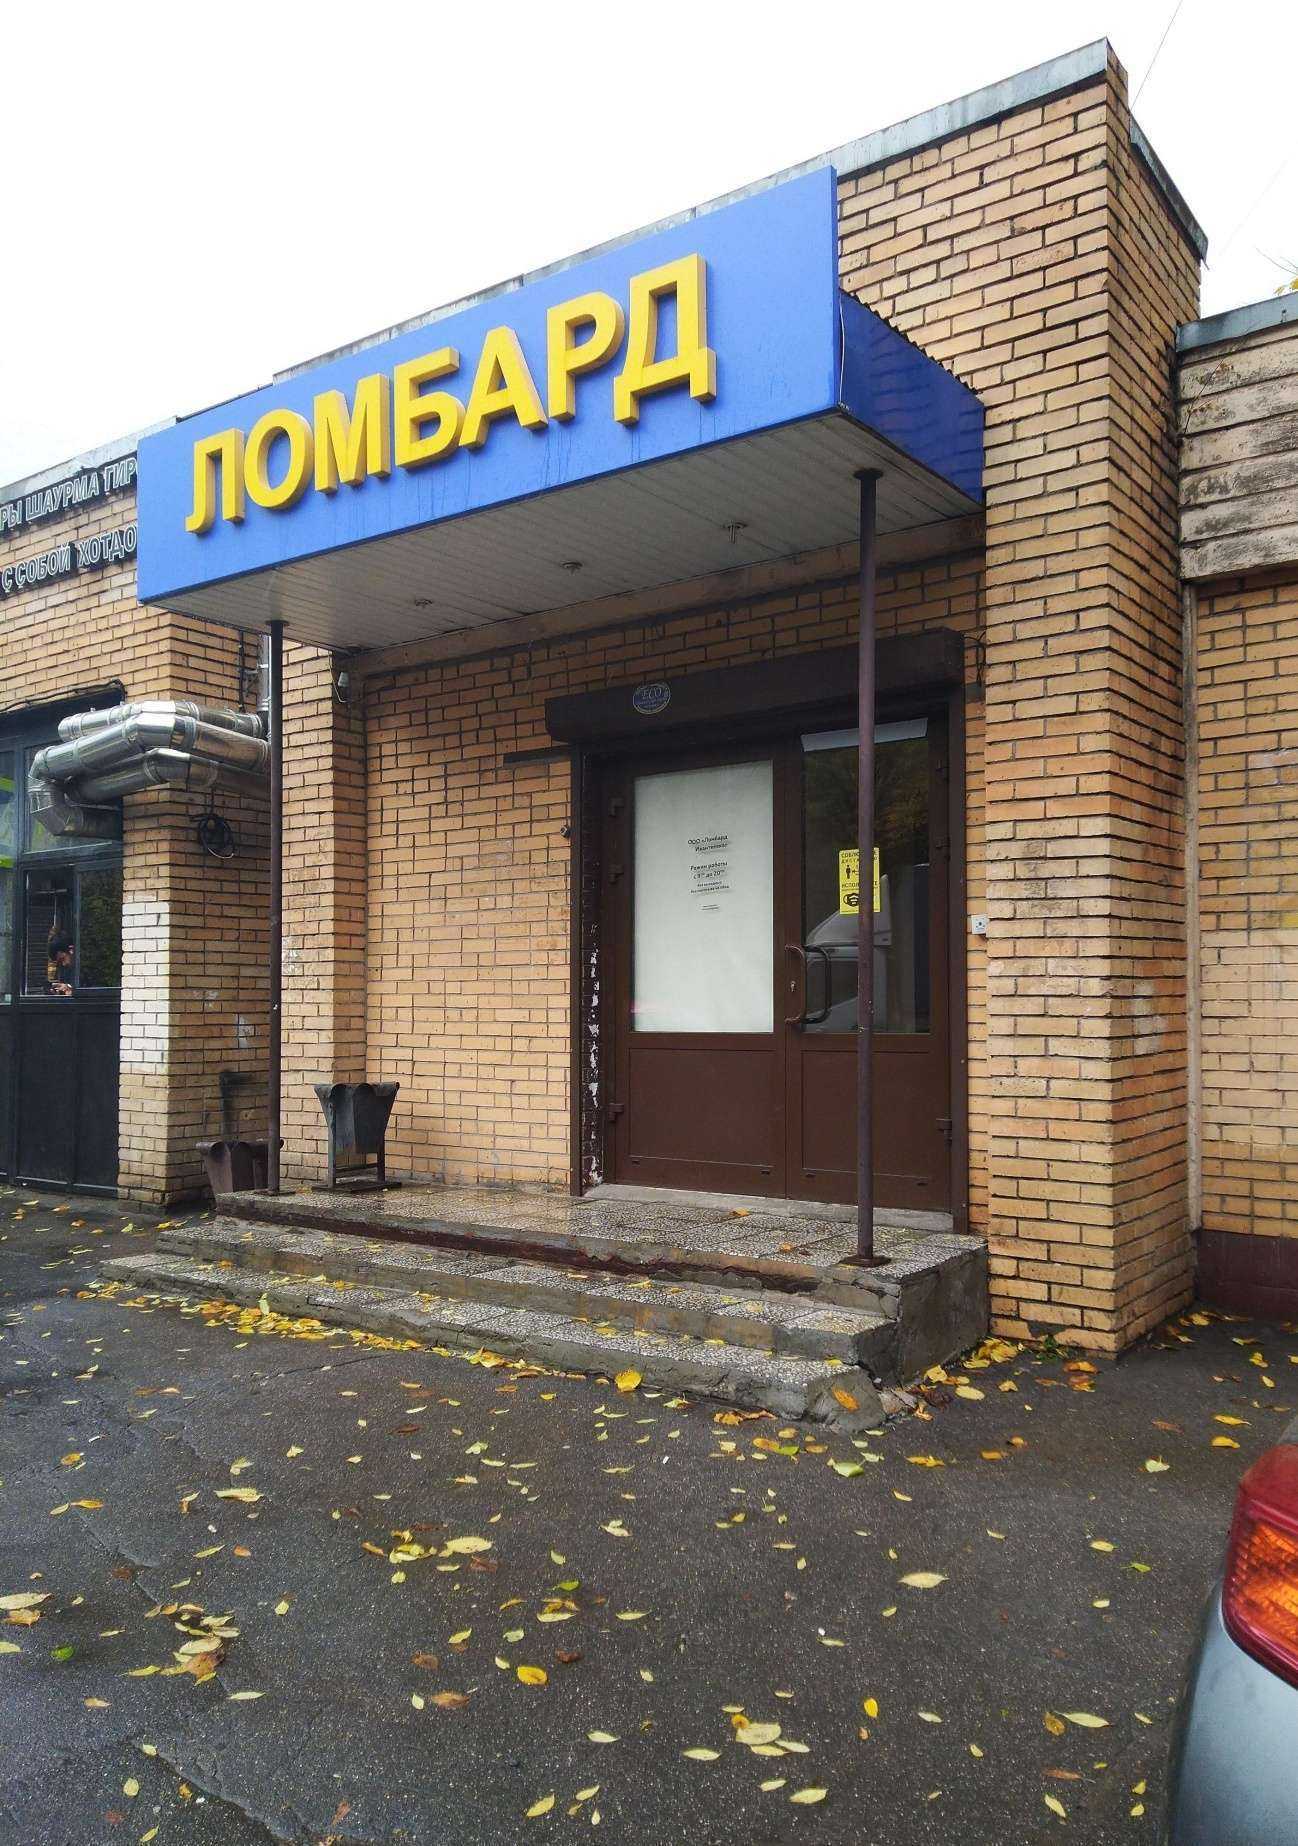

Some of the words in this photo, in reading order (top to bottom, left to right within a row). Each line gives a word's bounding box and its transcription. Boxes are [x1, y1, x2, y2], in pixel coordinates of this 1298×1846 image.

[185, 251, 717, 535] ЛОМБАРД
[26, 472, 100, 521] ШАУРМА
[14, 541, 71, 587] СОБОЙ
